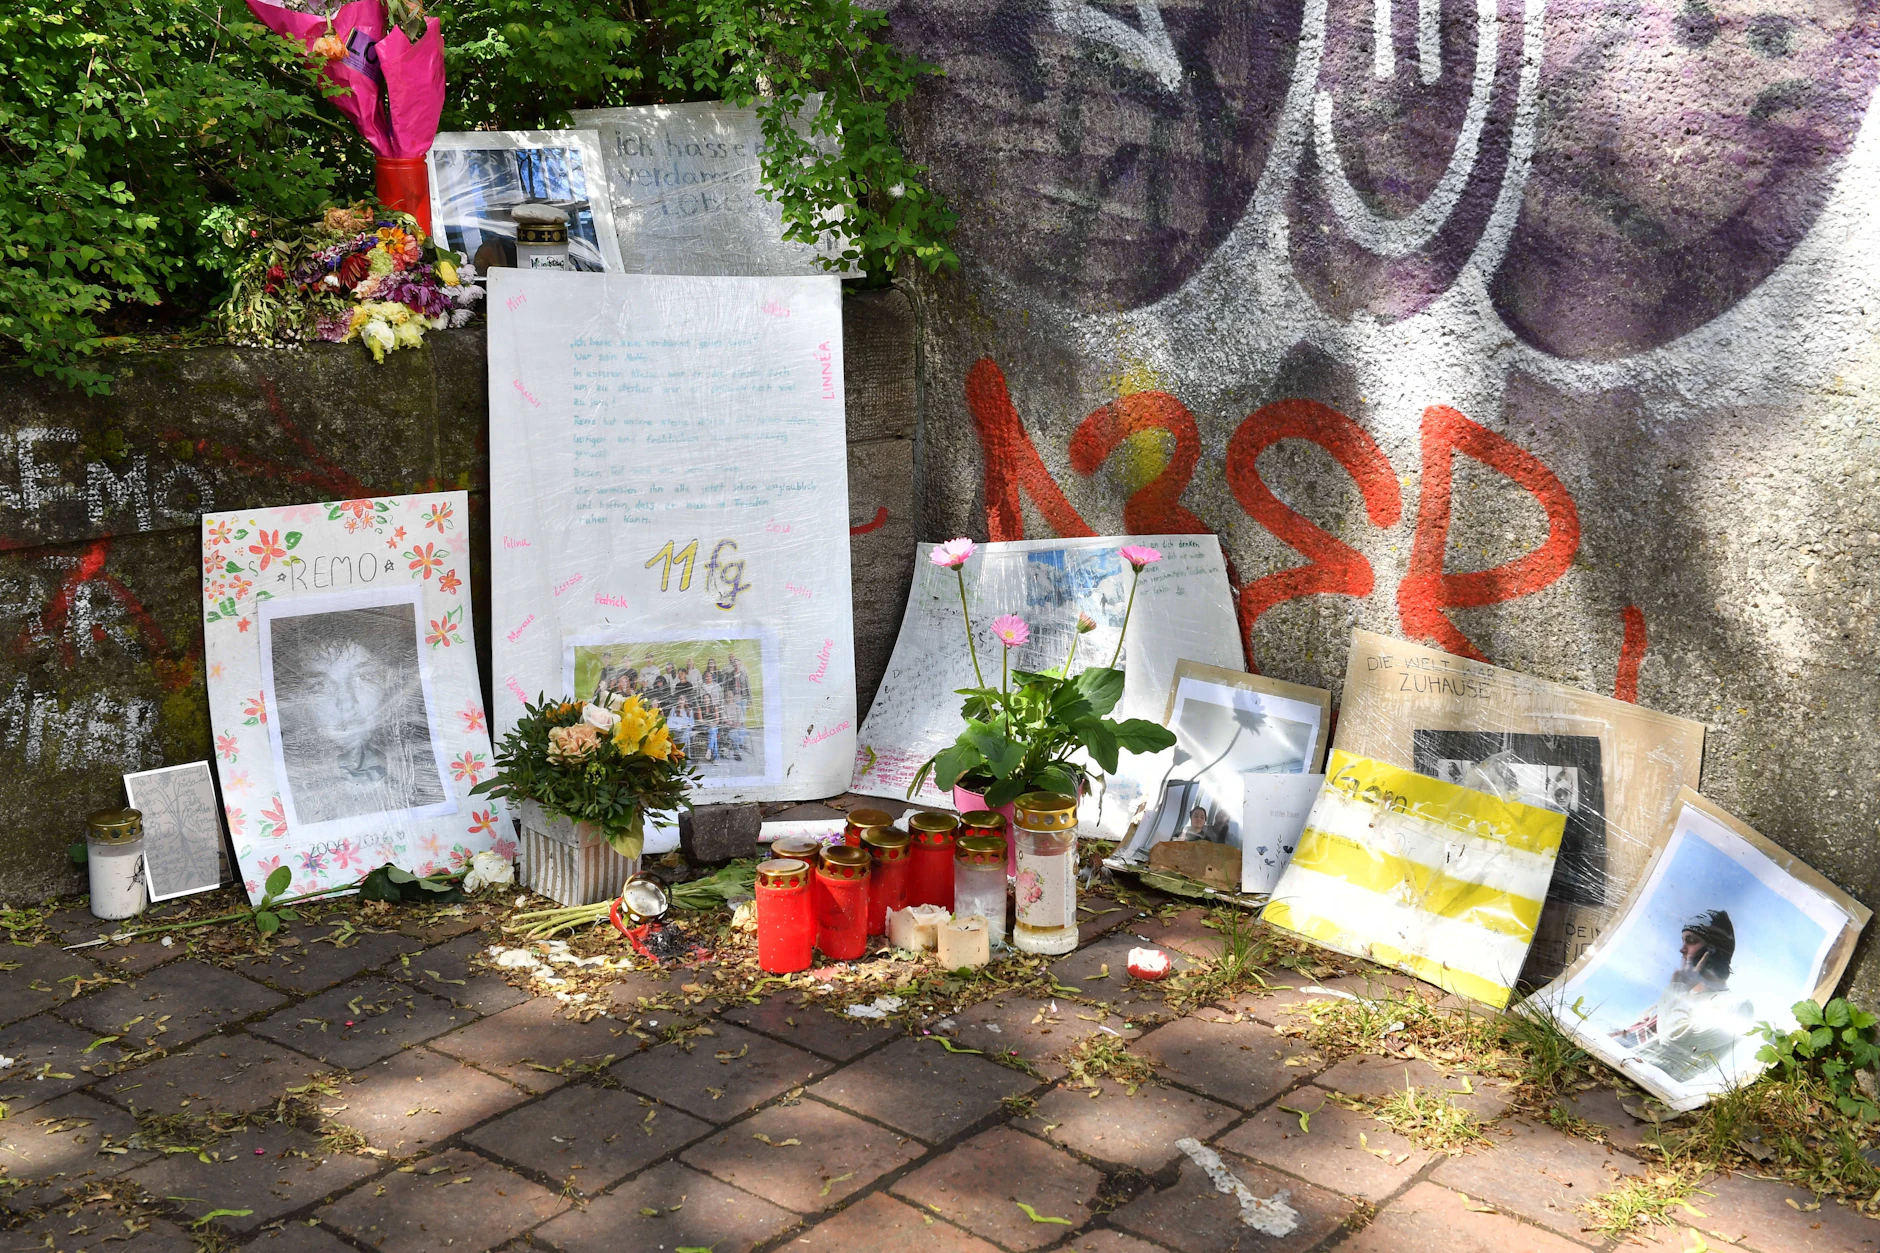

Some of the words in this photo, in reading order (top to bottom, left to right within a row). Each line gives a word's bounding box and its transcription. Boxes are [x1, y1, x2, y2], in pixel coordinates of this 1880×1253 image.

[666, 131, 747, 159] hasse
[667, 369, 687, 379] war
[813, 340, 836, 401] LINNÉA
[596, 384, 609, 392] zu
[778, 382, 797, 392] viel
[573, 397, 586, 407] zu
[596, 486, 637, 495] vermissen
[649, 484, 664, 494] ihn
[674, 484, 690, 494] alle
[731, 483, 758, 494] schon
[576, 500, 593, 511] und
[635, 499, 655, 511] dass
[1162, 538, 1174, 549] dich
[1178, 539, 1201, 549] denken
[290, 551, 378, 592] REMO
[644, 537, 699, 594] 11
[703, 537, 753, 612] fg
[593, 591, 629, 609] Patrick
[807, 637, 835, 686] Pauline
[1366, 655, 1394, 672] DIE
[1404, 656, 1451, 673] WELT
[1398, 672, 1492, 700] ZUHAUSE
